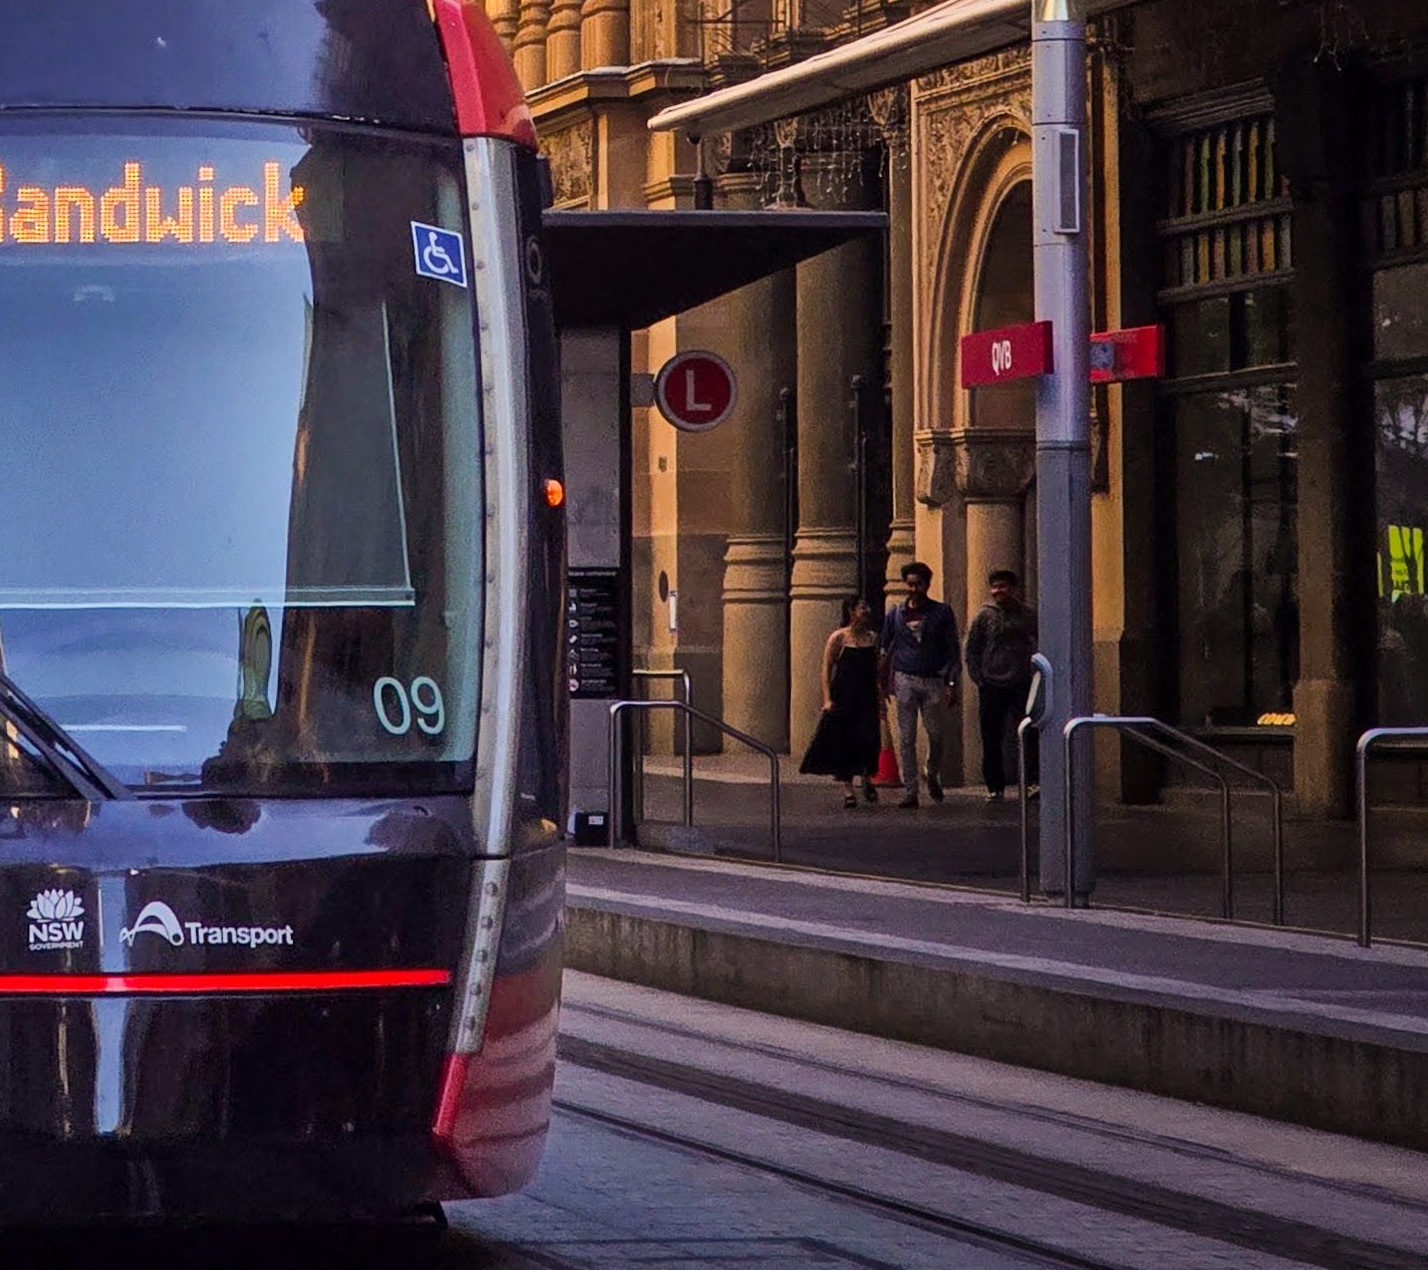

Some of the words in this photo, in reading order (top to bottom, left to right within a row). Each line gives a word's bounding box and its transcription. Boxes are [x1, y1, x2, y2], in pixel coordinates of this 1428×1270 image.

[992, 340, 1012, 375] QVB
[686, 369, 712, 411] L
[373, 676, 445, 735] 09
[29, 922, 84, 944] NSW
[29, 941, 84, 952] GOVERNMENT
[185, 922, 293, 948] Transport
